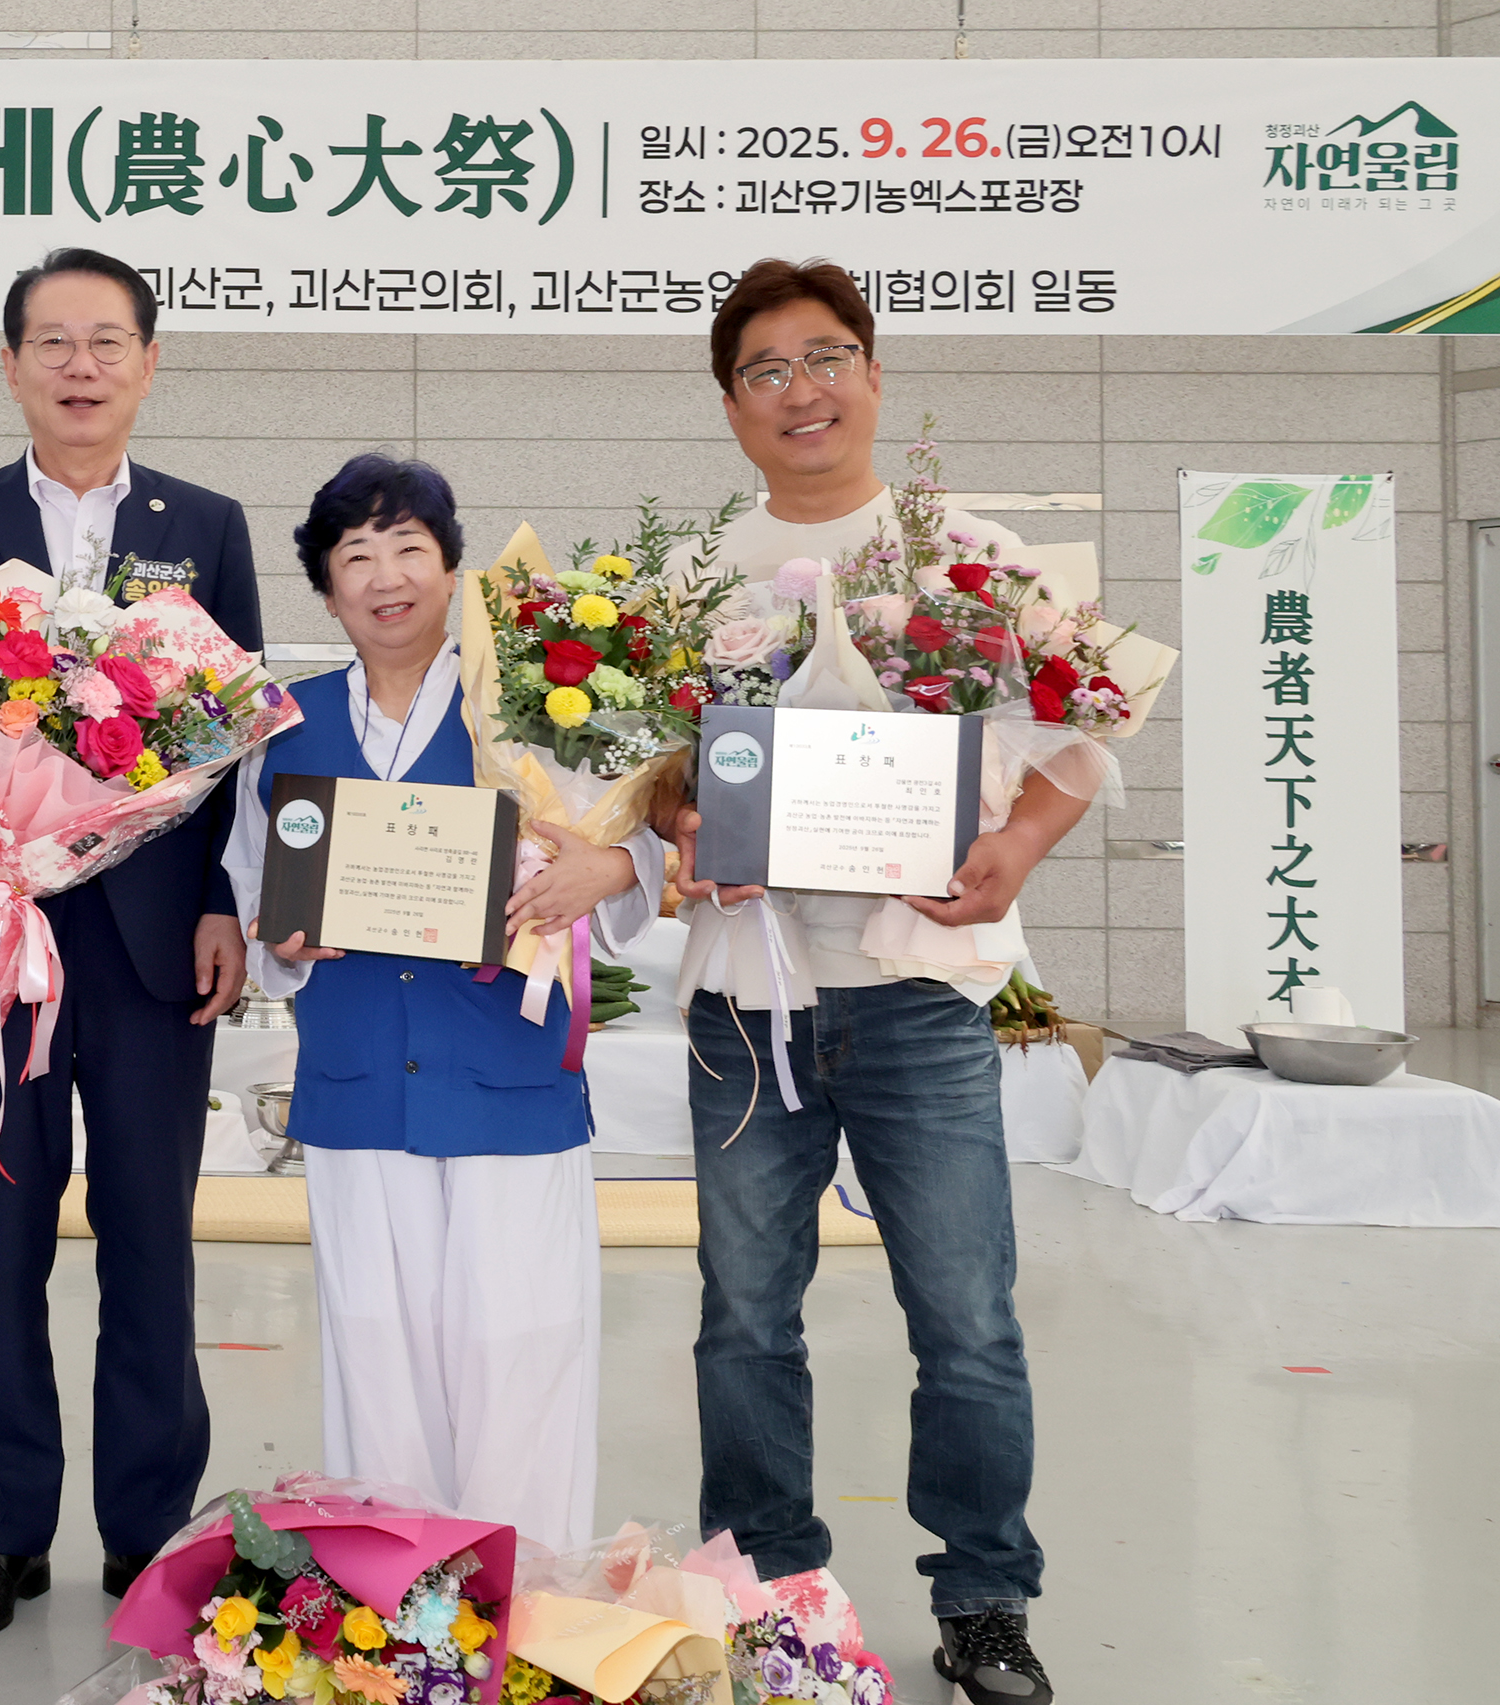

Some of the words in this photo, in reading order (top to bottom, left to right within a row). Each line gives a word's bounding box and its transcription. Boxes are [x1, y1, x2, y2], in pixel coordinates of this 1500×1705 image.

[639, 124, 707, 160] 일시
[736, 125, 850, 160] 2025.
[860, 117, 908, 160] 9.
[1265, 123, 1320, 138] 청정괴산
[1263, 142, 1458, 192] 자연울림
[639, 180, 707, 215] 장소
[735, 179, 1084, 215] 괴산유기농엑스포광장
[288, 268, 517, 318] 괴산군의회,
[1031, 269, 1119, 315] 일동
[131, 561, 187, 582] 괴산군수
